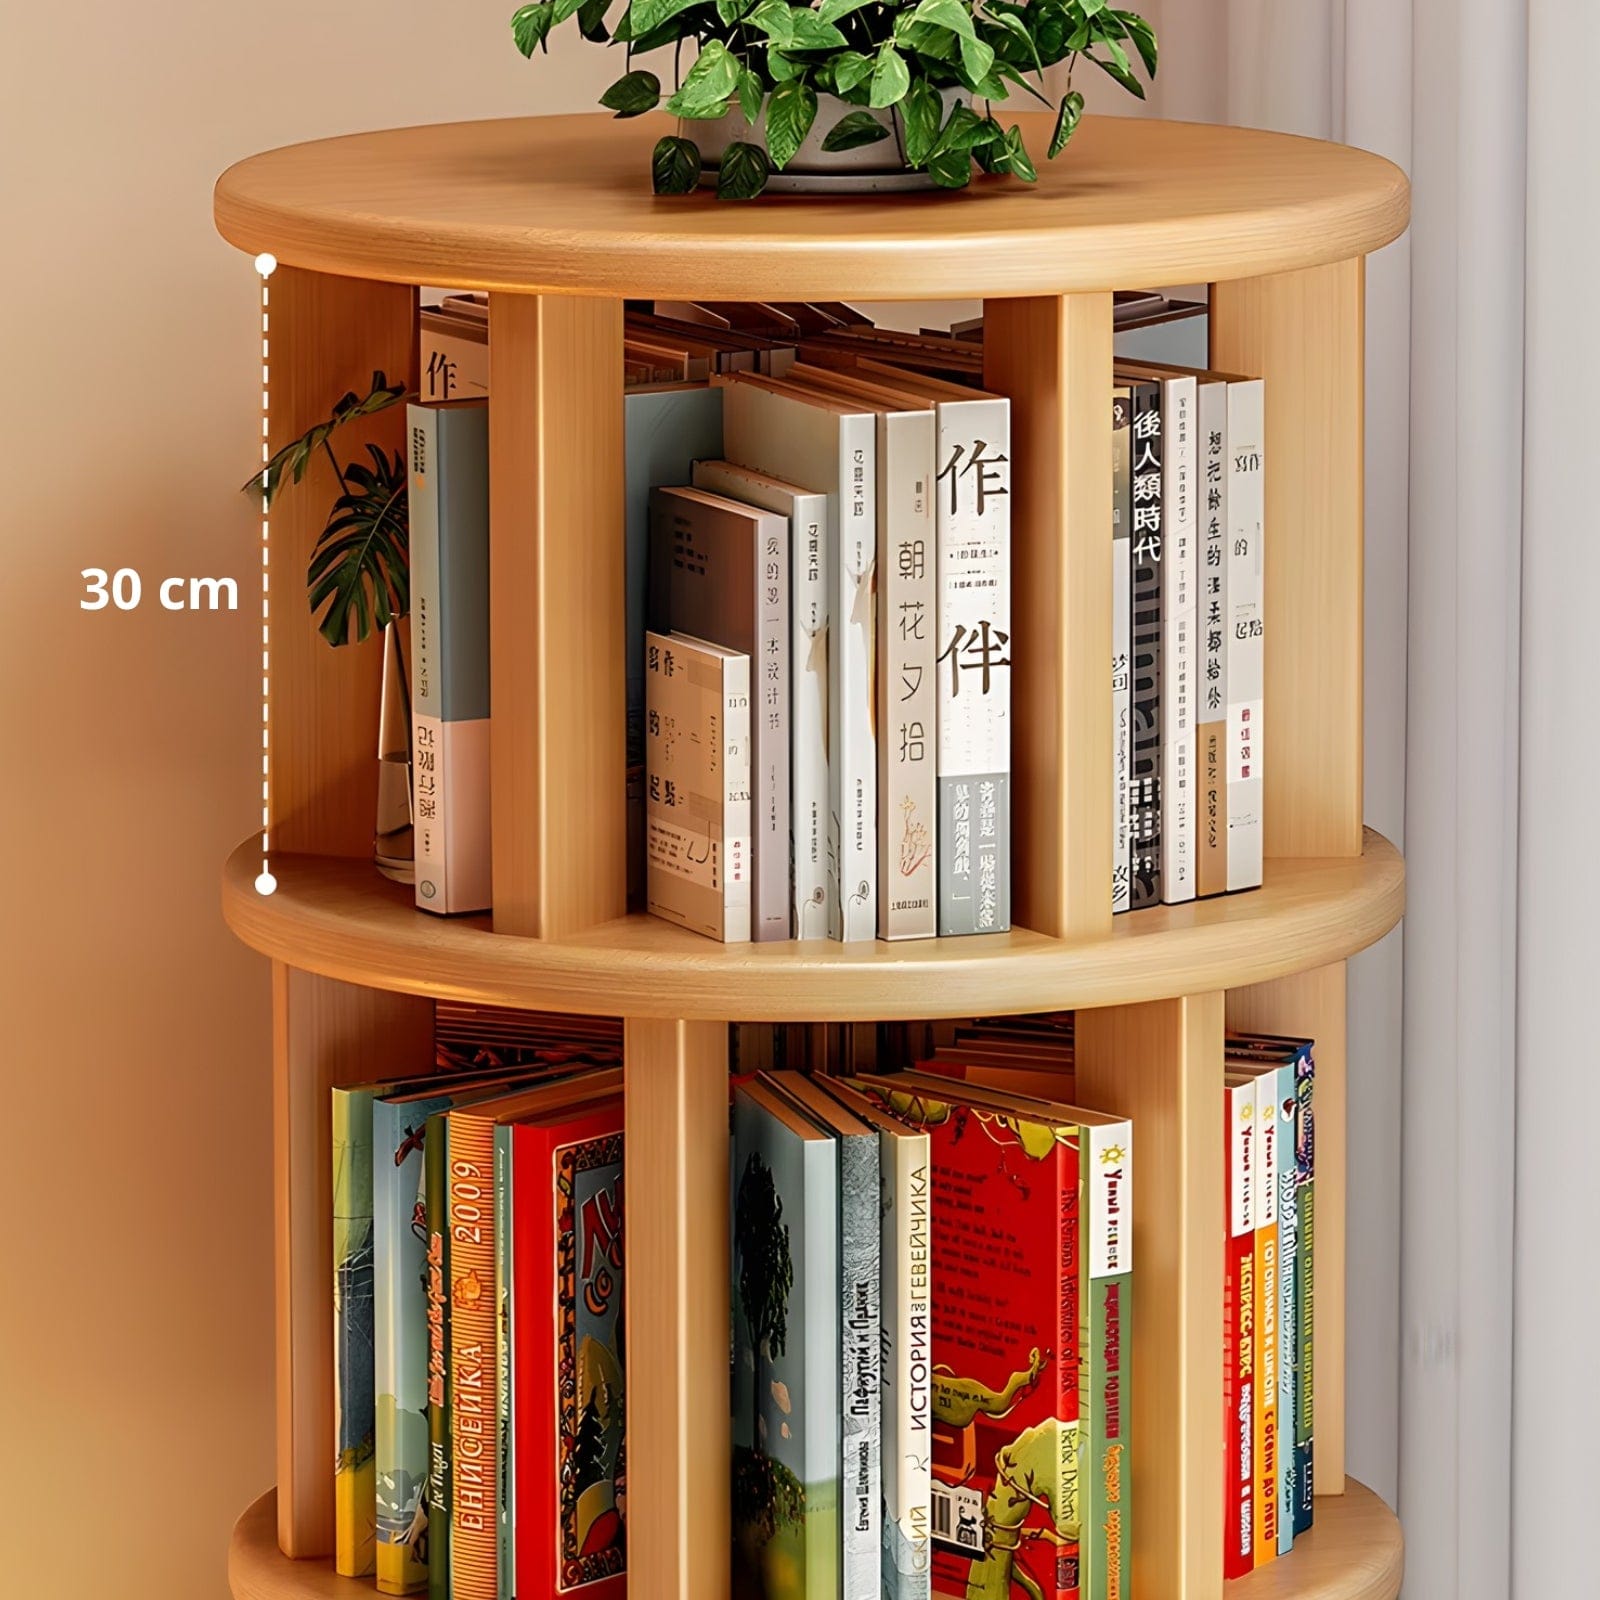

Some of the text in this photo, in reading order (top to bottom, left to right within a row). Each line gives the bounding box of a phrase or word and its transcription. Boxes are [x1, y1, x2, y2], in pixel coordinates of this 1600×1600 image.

[1132, 408, 1161, 565] 後人類時代
[898, 540, 925, 762] 朝花夕拾
[453, 1161, 481, 1245] 2009
[909, 1166, 927, 1301] ГЕВЕЙЧИКА
[458, 1343, 484, 1532] ЕНИСЕЙКА
[910, 1315, 927, 1430] ИСТОРИЯ
